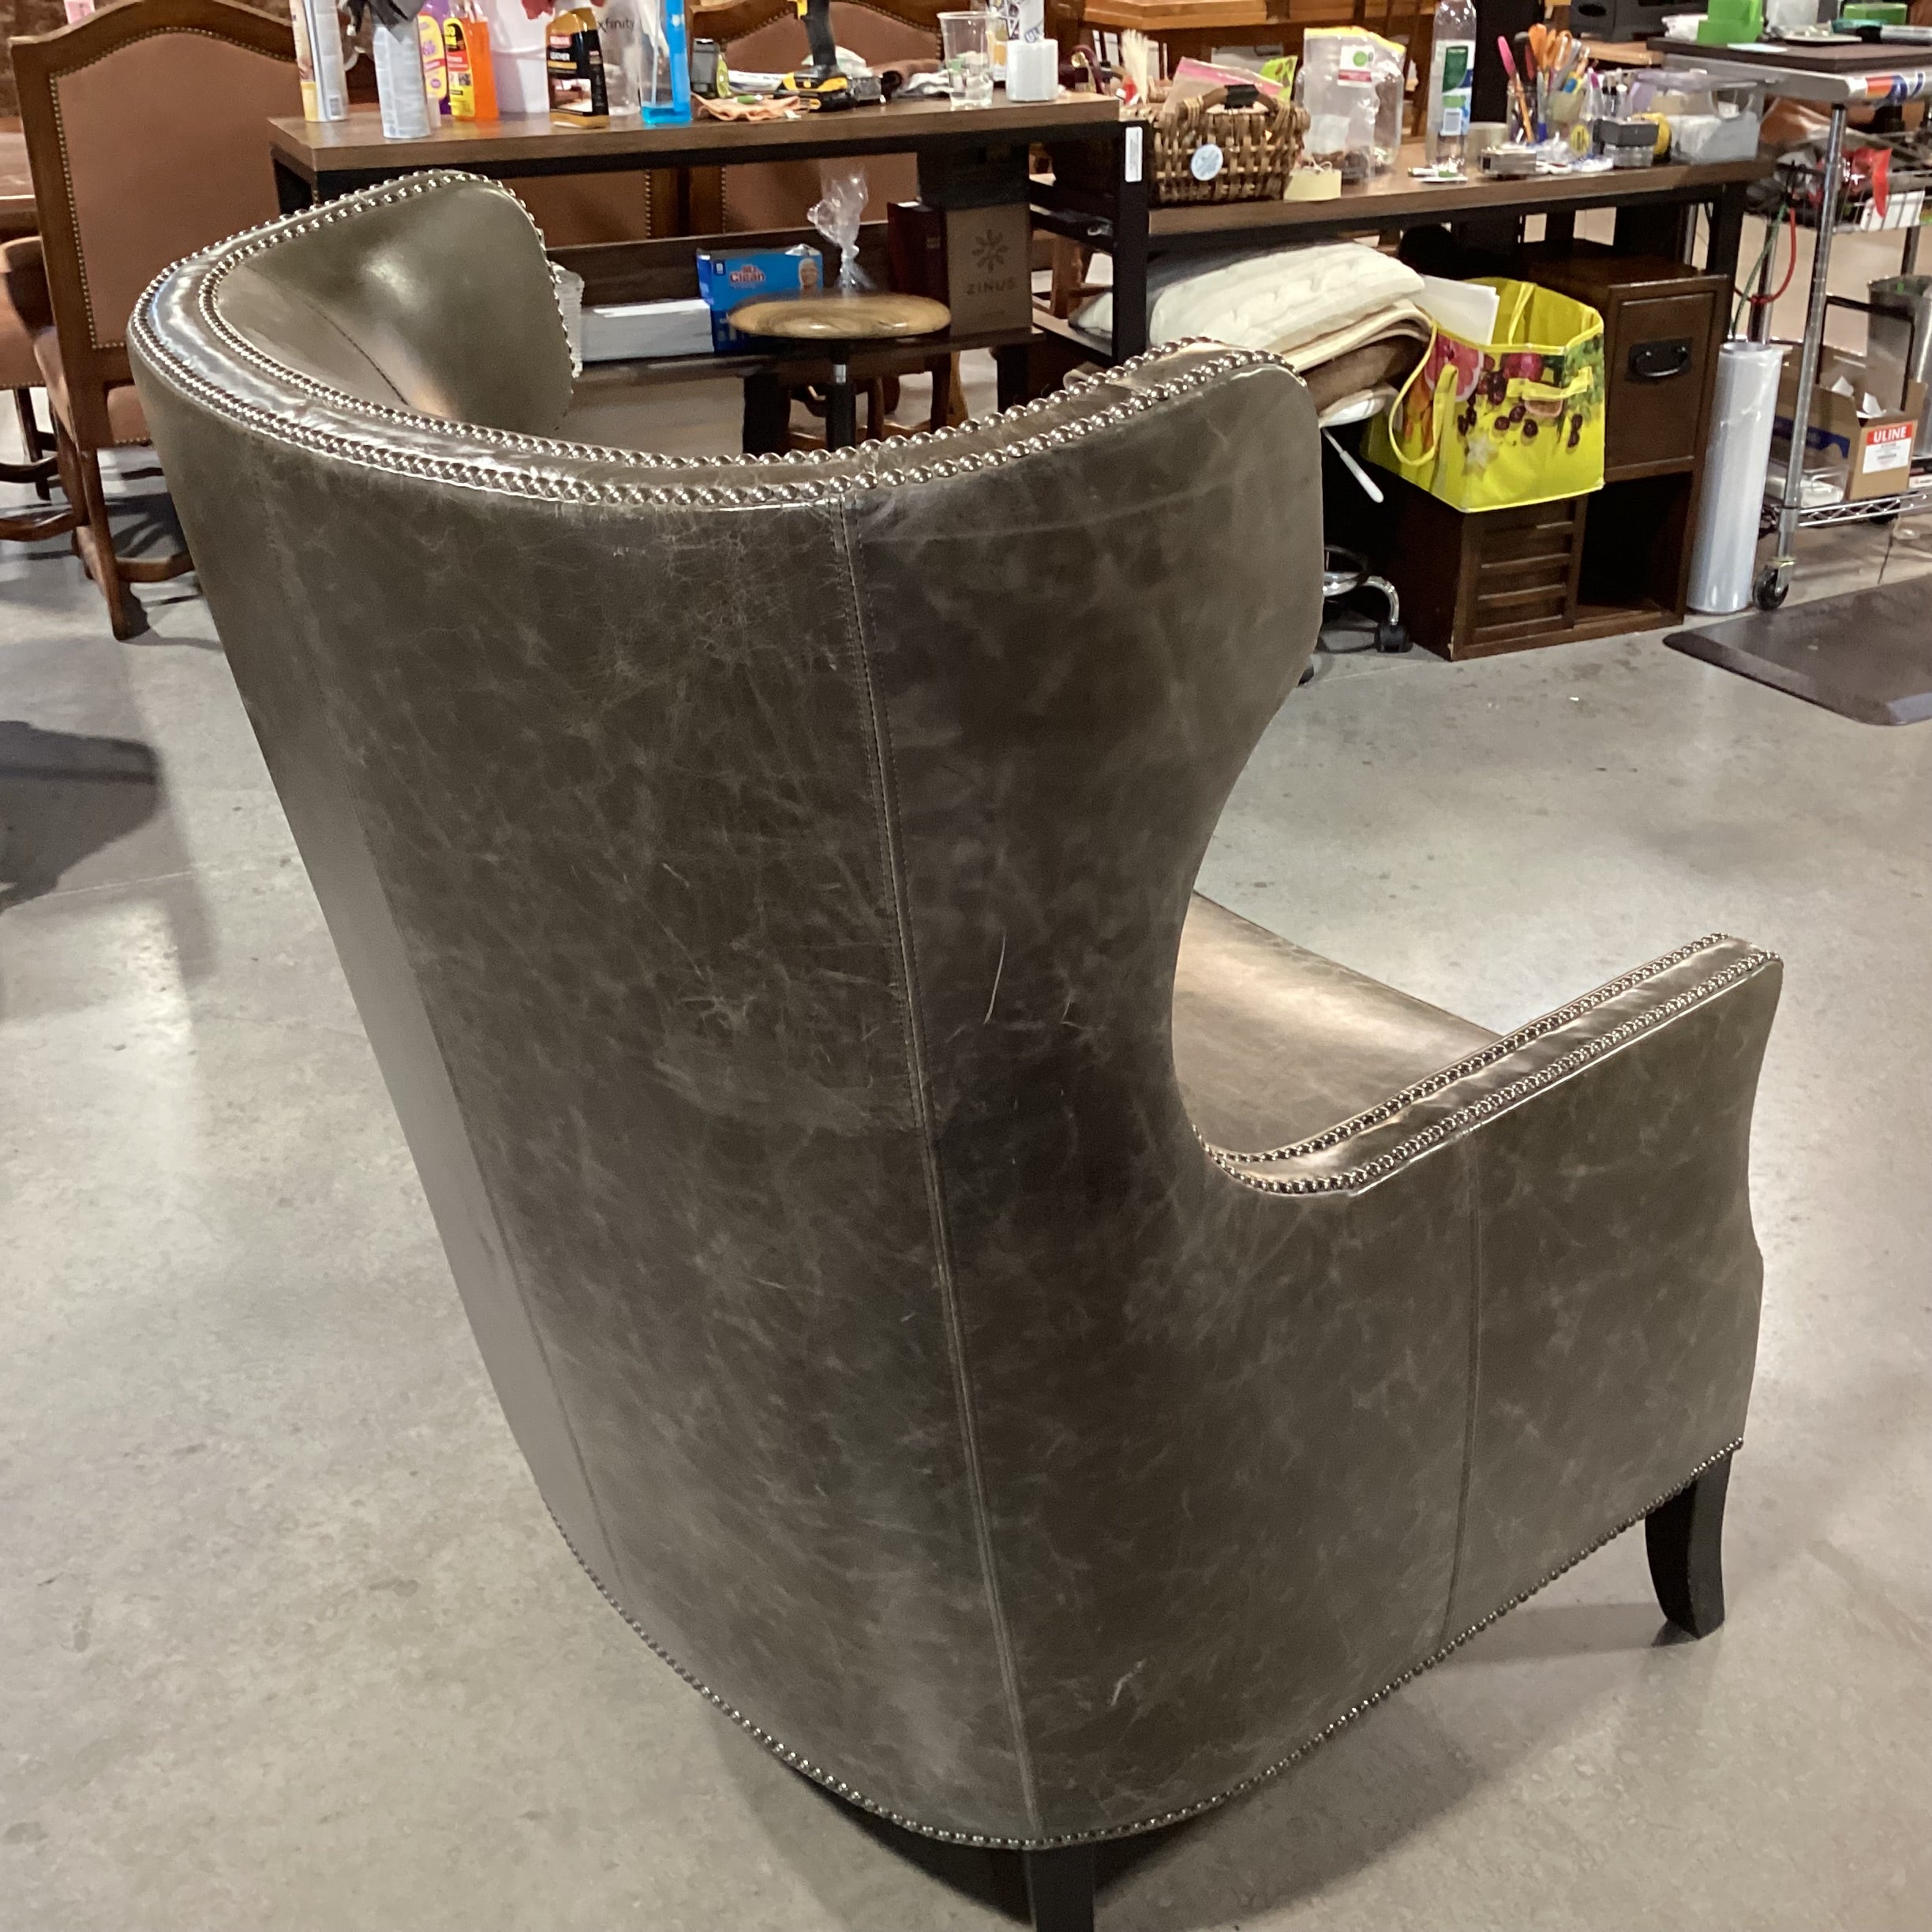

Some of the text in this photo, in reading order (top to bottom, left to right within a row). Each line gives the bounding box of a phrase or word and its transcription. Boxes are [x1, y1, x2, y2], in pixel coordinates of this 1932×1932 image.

[597, 17, 635, 32] xfinity
[965, 276, 1017, 295] ZINUS
[1873, 426, 1907, 443] ULINE
